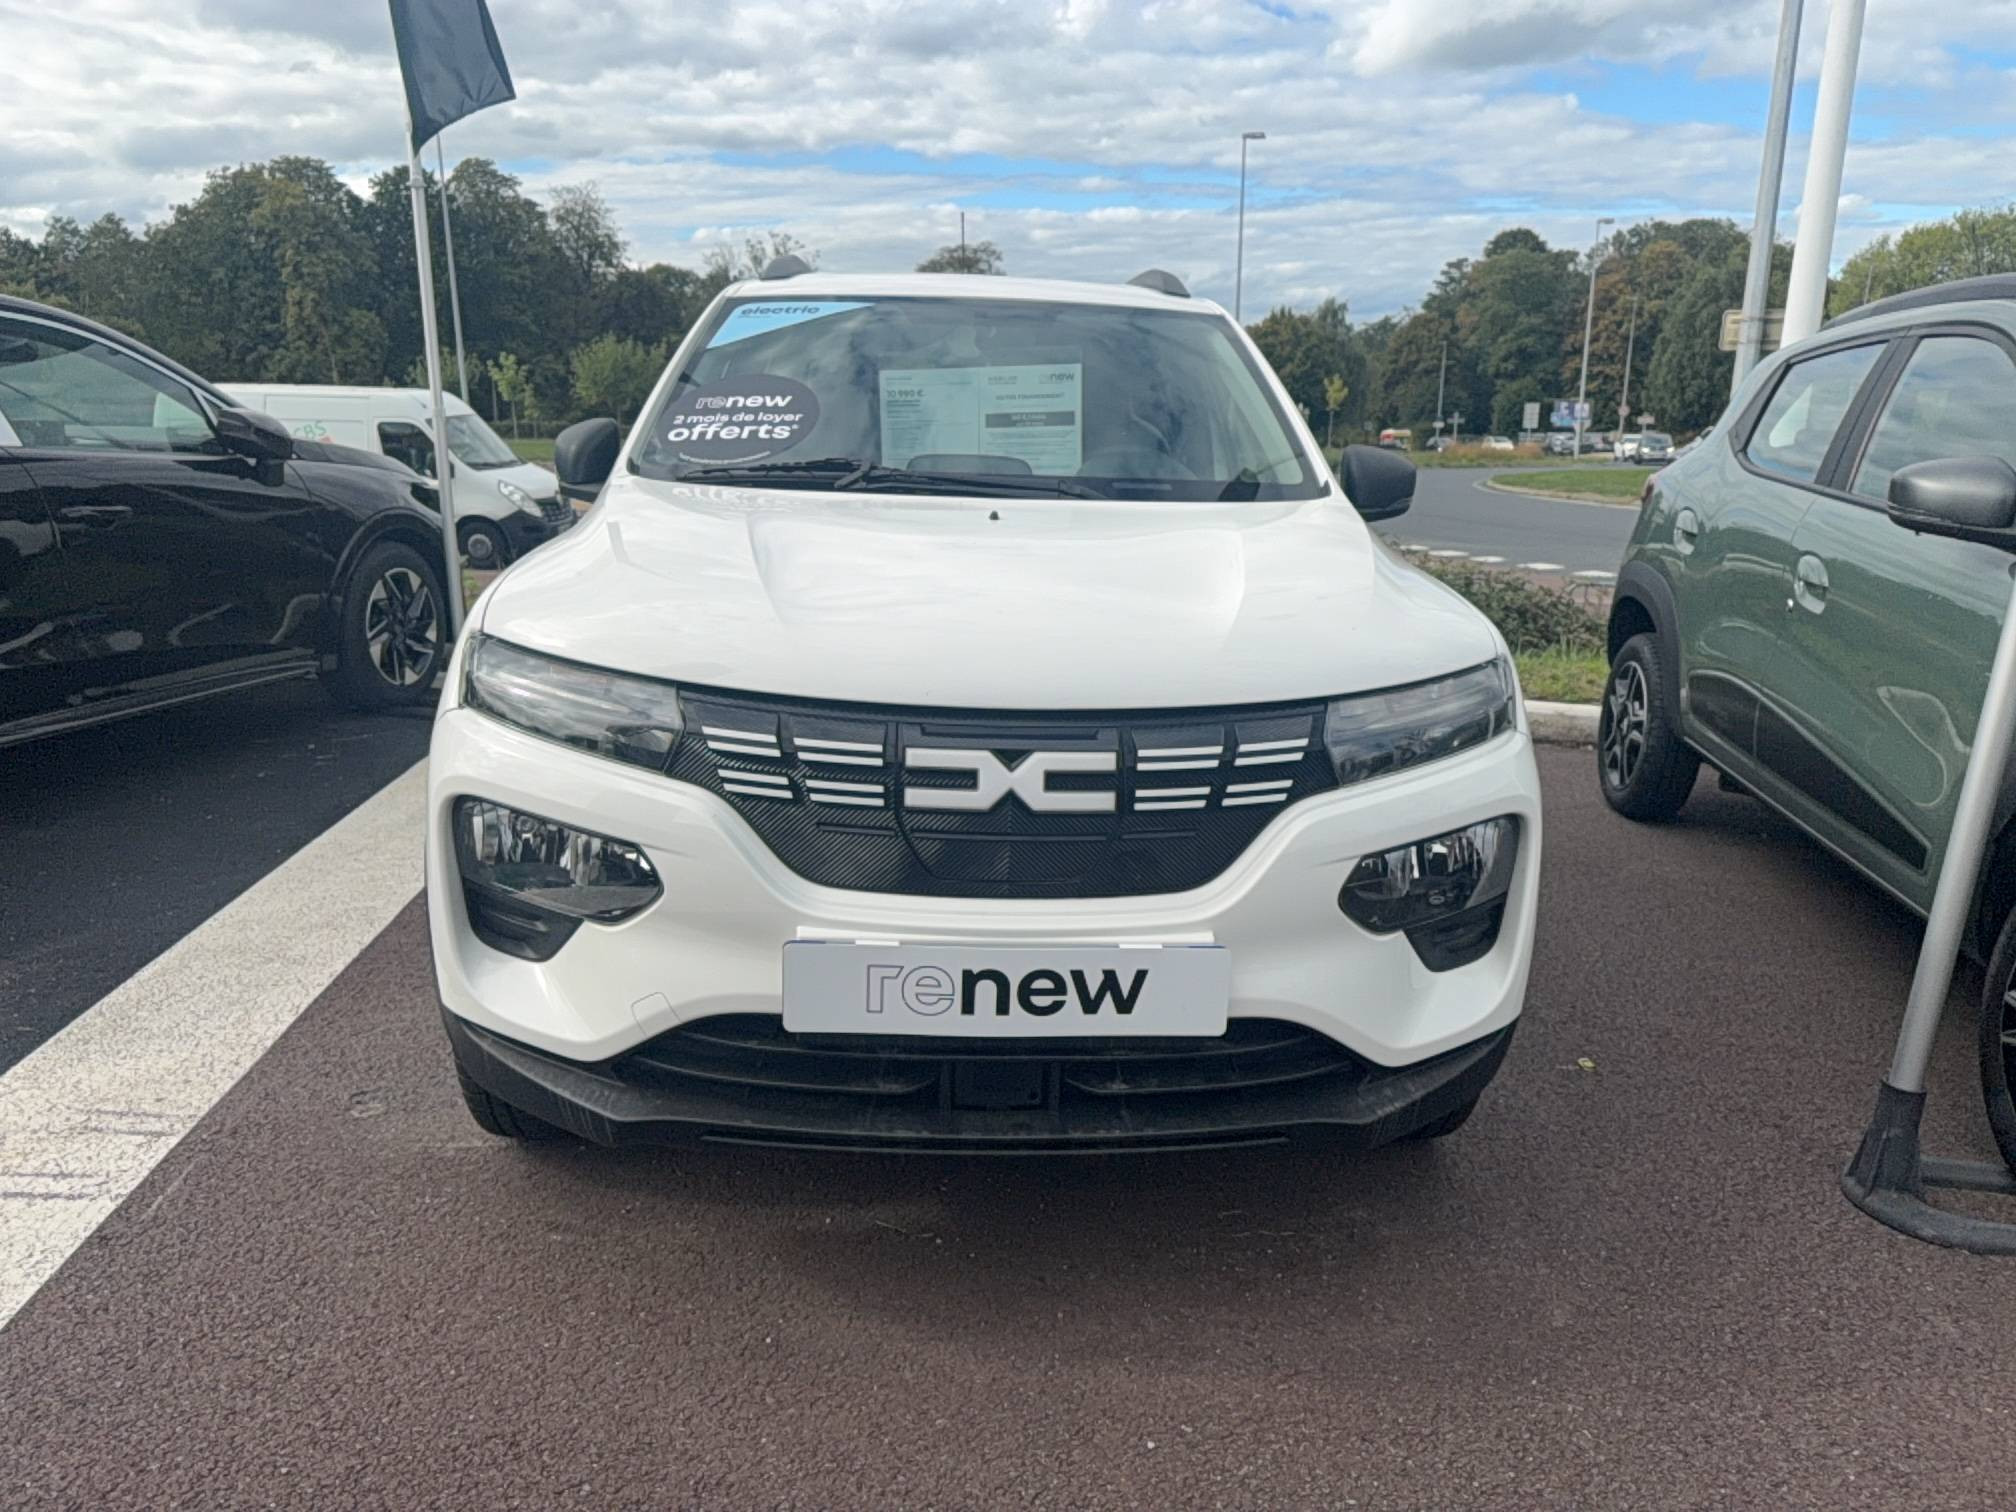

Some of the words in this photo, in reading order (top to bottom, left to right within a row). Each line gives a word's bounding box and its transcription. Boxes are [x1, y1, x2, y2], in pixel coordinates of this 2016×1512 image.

[695, 395, 793, 410] renew
[673, 414, 685, 426] 2
[687, 412, 730, 424] mois
[732, 411, 755, 422] de
[757, 411, 804, 423] loyer
[866, 963, 1150, 1017] renew
